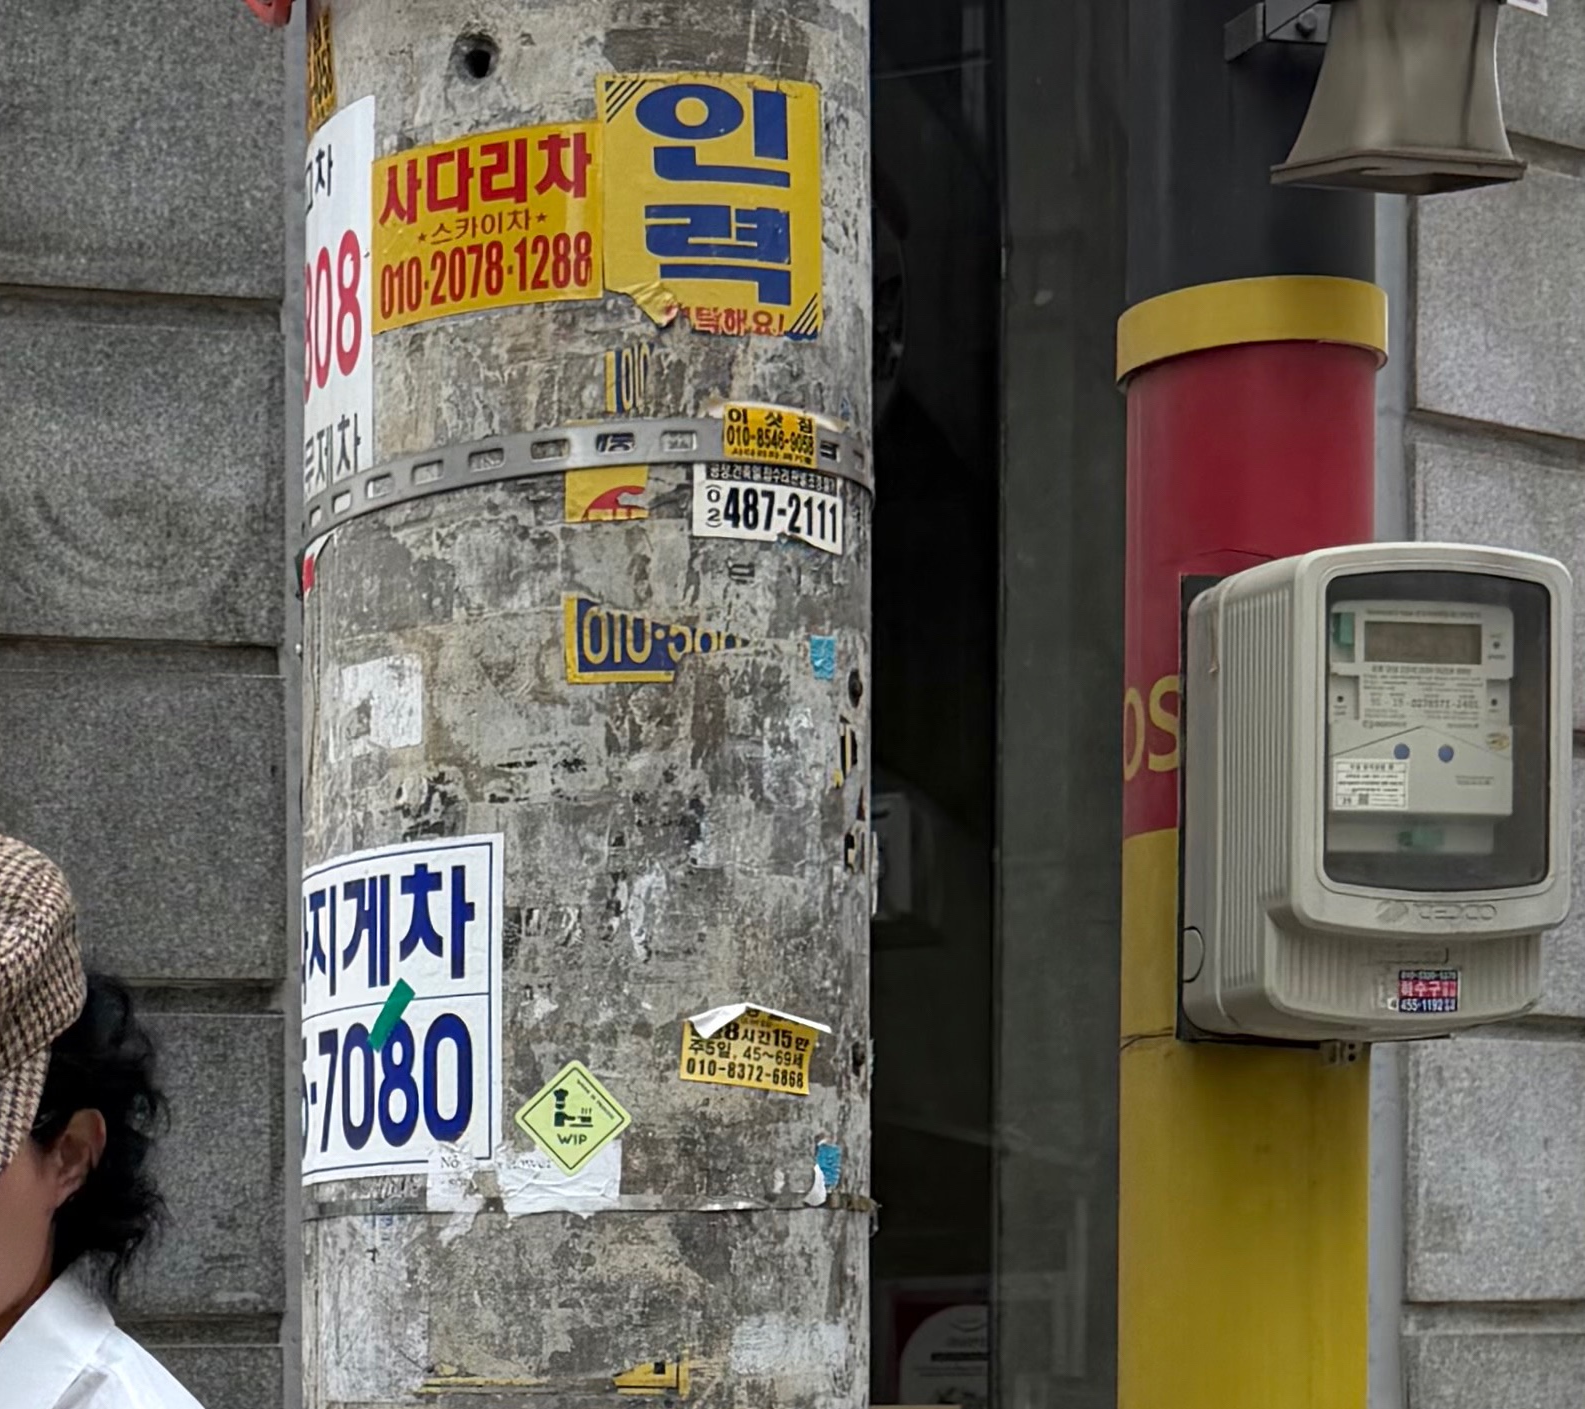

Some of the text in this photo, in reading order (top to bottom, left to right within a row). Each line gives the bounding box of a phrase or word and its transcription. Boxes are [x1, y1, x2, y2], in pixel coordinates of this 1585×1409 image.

[379, 132, 592, 225] 사다리차
[430, 208, 531, 245] 스카이차
[723, 486, 837, 543] 487-2111
[686, 1057, 804, 1089] 010-8372-6868
[556, 1133, 588, 1145] WIP
